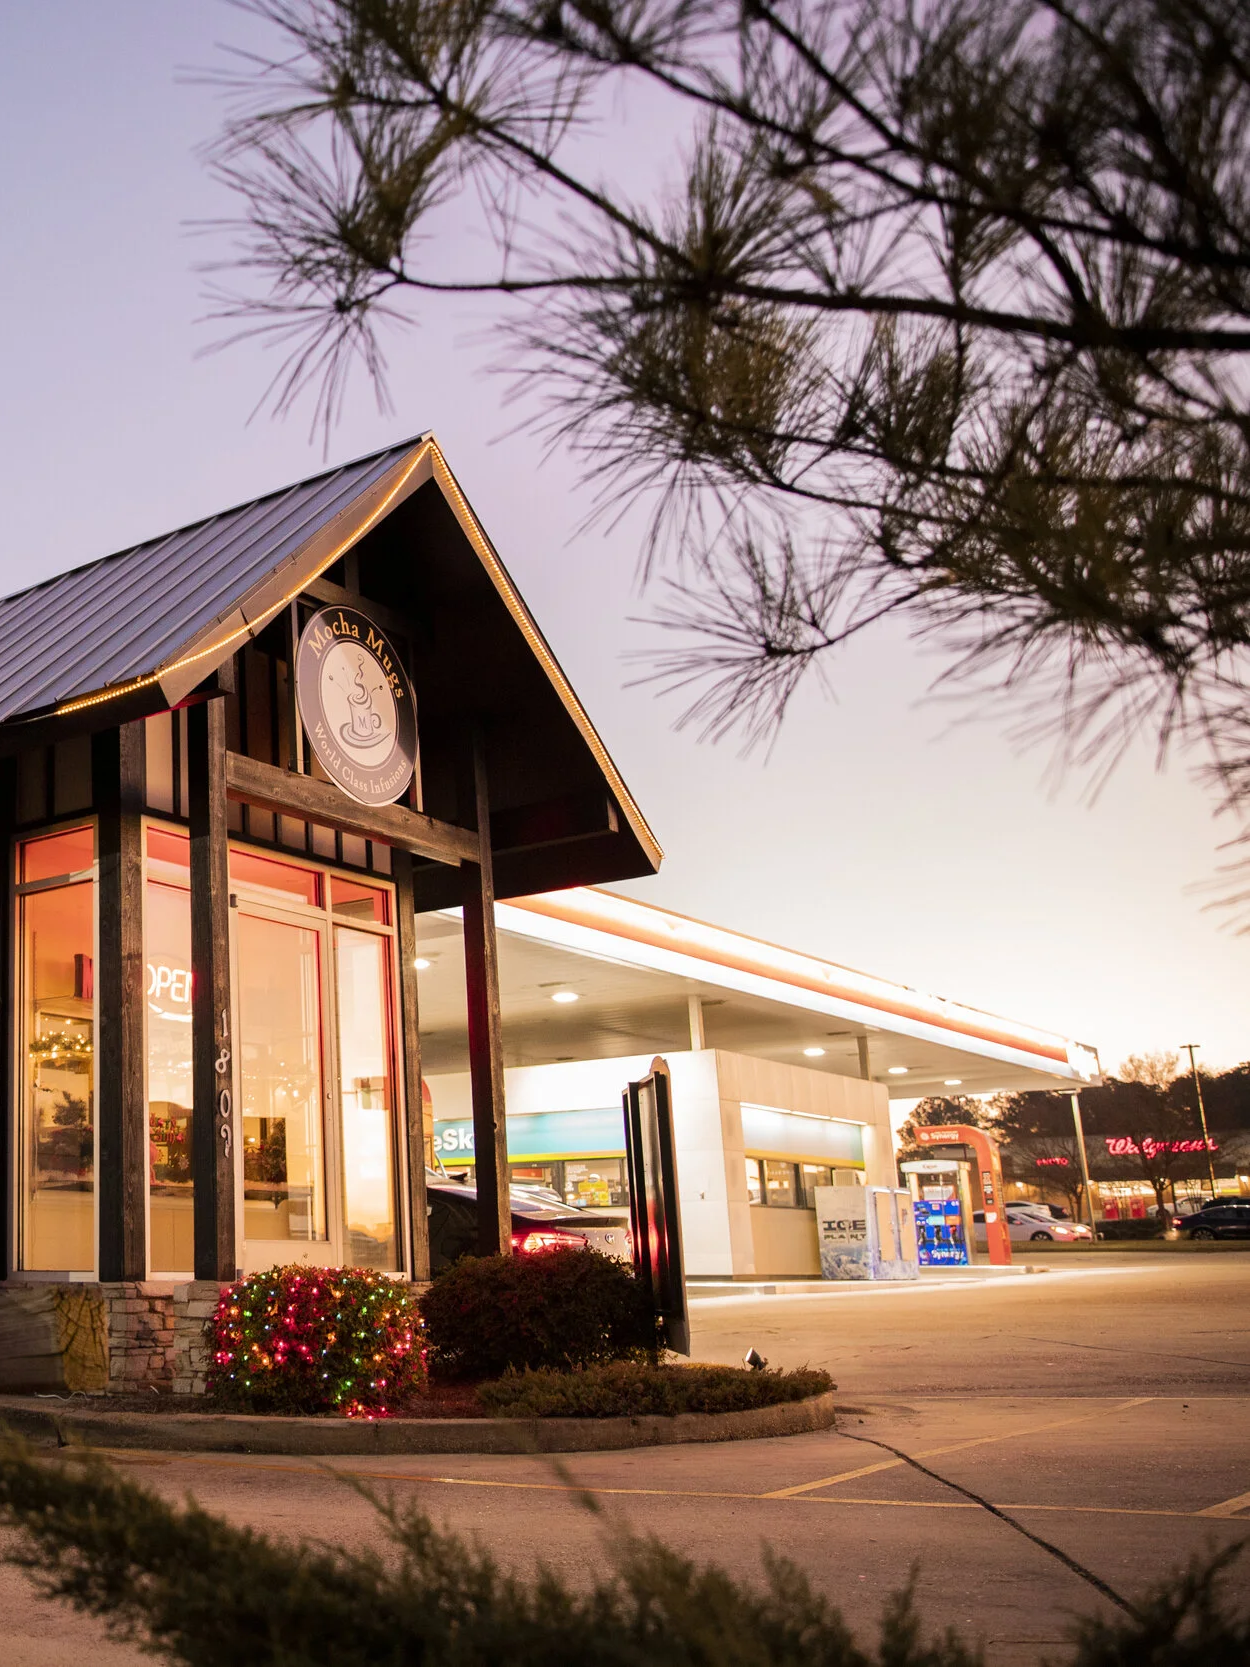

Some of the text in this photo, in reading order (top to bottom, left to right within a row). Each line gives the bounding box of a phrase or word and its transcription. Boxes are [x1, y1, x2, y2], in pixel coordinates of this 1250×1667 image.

[307, 612, 403, 699] Mocha Mugs
[315, 721, 407, 794] World Class Infusions
